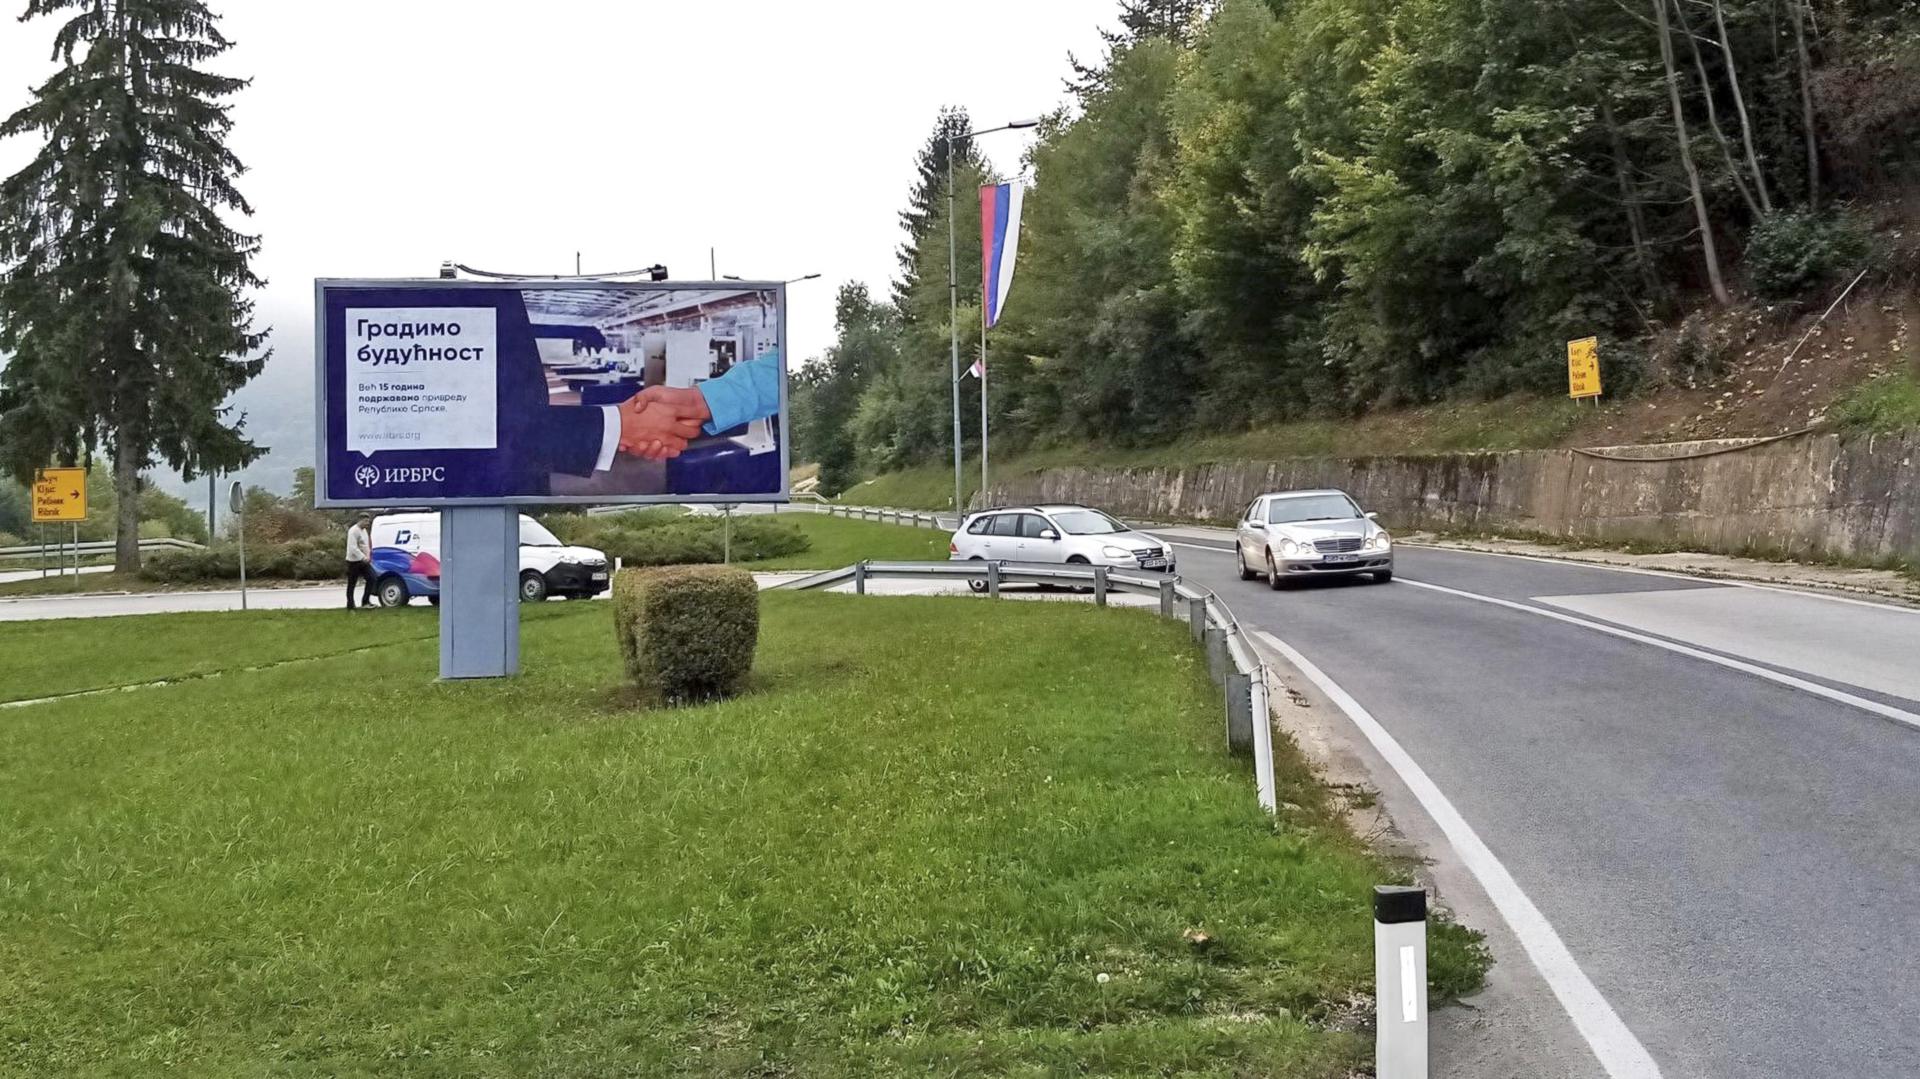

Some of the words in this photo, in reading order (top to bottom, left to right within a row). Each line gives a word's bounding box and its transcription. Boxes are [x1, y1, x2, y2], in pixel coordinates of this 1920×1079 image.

[357, 318, 462, 341] Градимо
[357, 343, 484, 366] будућност
[379, 382, 389, 391] 15
[391, 383, 425, 392] година
[384, 466, 445, 483] ИРБРС
